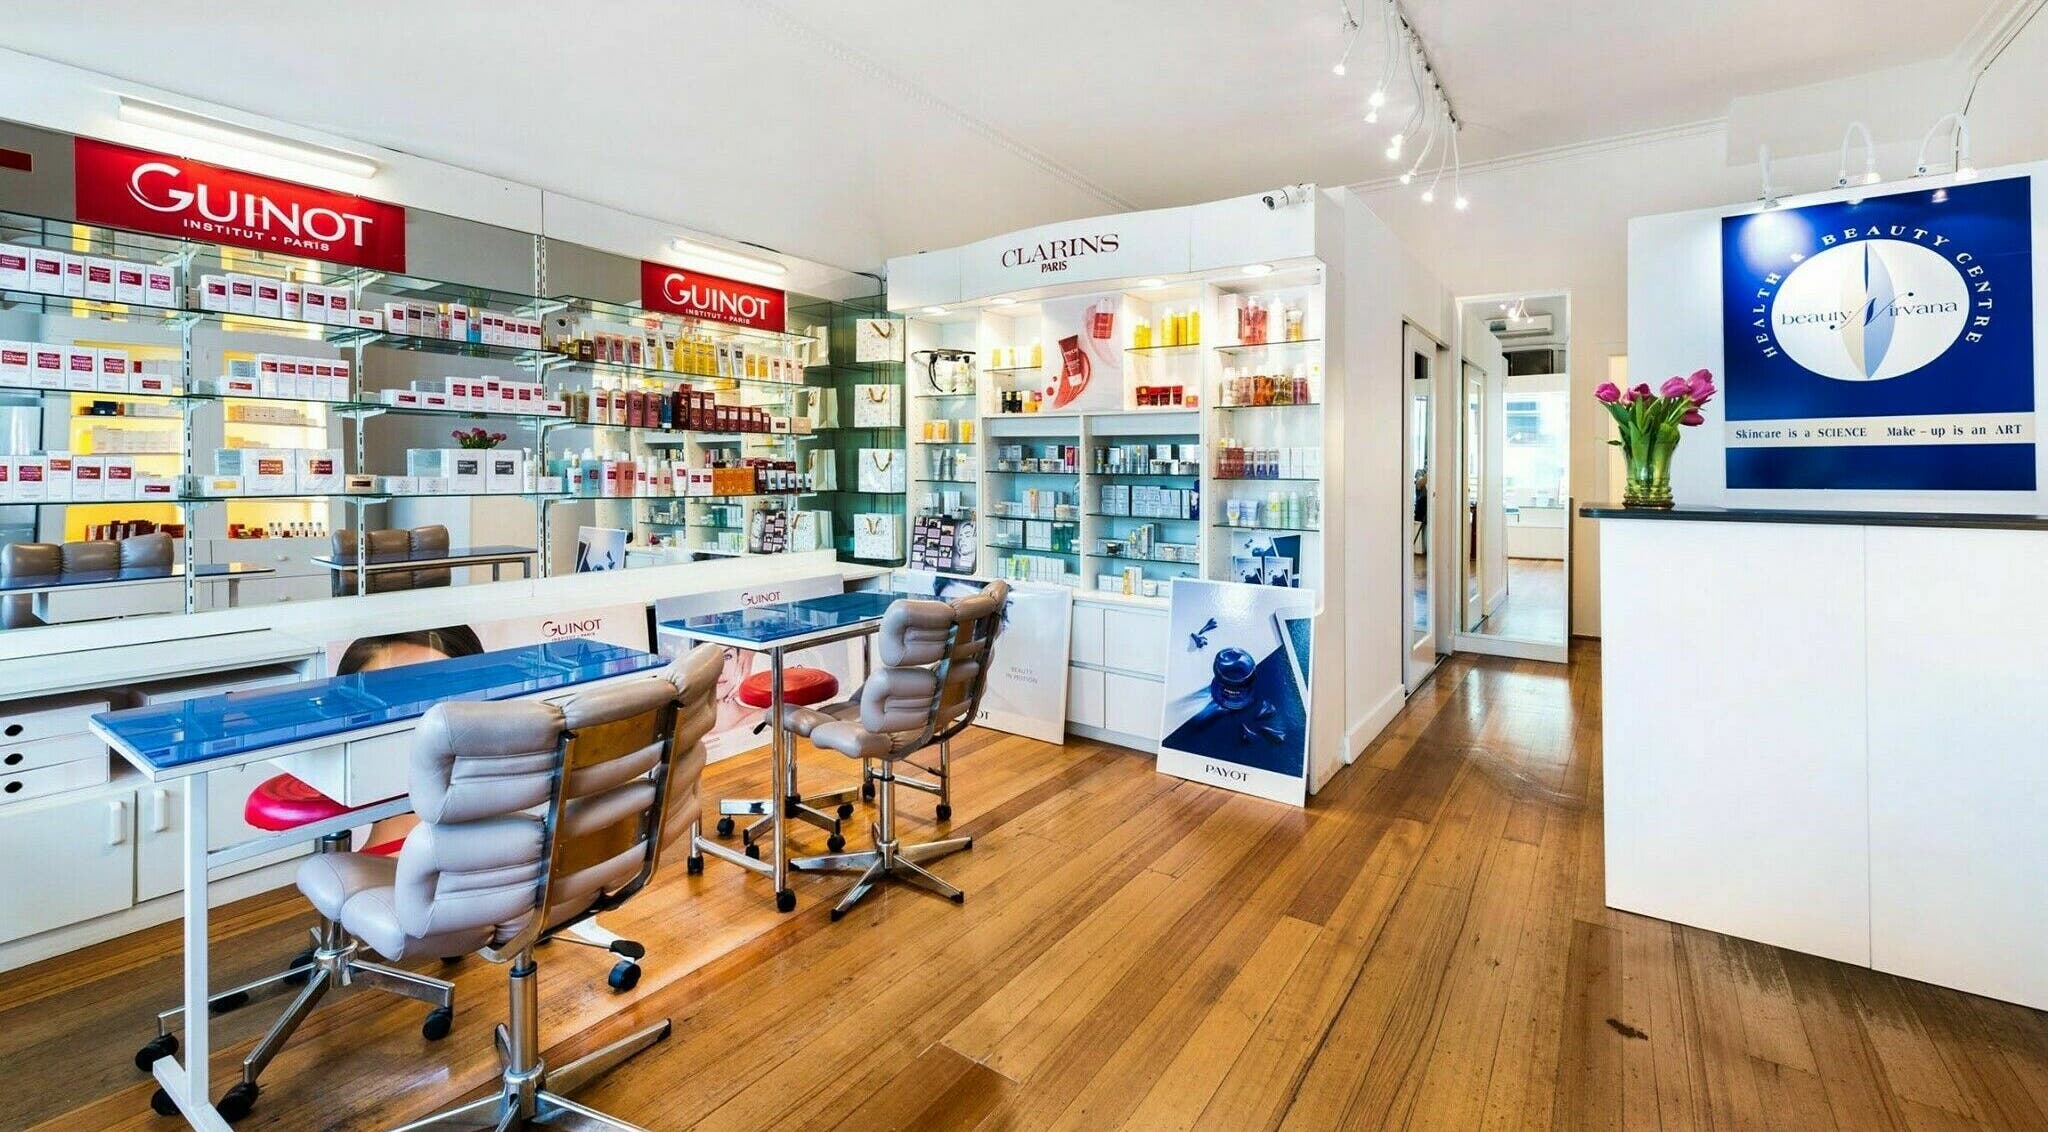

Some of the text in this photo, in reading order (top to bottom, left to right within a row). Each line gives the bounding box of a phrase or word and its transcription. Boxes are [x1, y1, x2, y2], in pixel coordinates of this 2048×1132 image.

[127, 162, 373, 247] GUINOT
[183, 218, 330, 252] INSTITUT PARIS
[1001, 233, 1119, 268] CLARINS
[1041, 260, 1068, 273] PARIS
[662, 273, 770, 320] GUINOT
[1752, 272, 1782, 358] HEALTH
[1821, 225, 1950, 247] BEAUTY
[1956, 252, 1994, 344] CENTRE
[685, 308, 750, 325] INSTITUT PARIS
[1781, 309, 1852, 326] beauty
[1735, 428, 1782, 439] Skincare
[1788, 428, 1798, 438] is
[1804, 429, 1811, 438] a
[1817, 427, 1868, 438] SCIENCE
[1887, 426, 1916, 437] Make
[1930, 427, 1946, 438] up
[1953, 425, 1964, 435] is
[1971, 426, 1987, 435] an
[1995, 424, 2023, 435] ART
[741, 591, 781, 606] GUINOT
[541, 619, 602, 638] GUINOT
[1205, 764, 1249, 782] PAYOT
